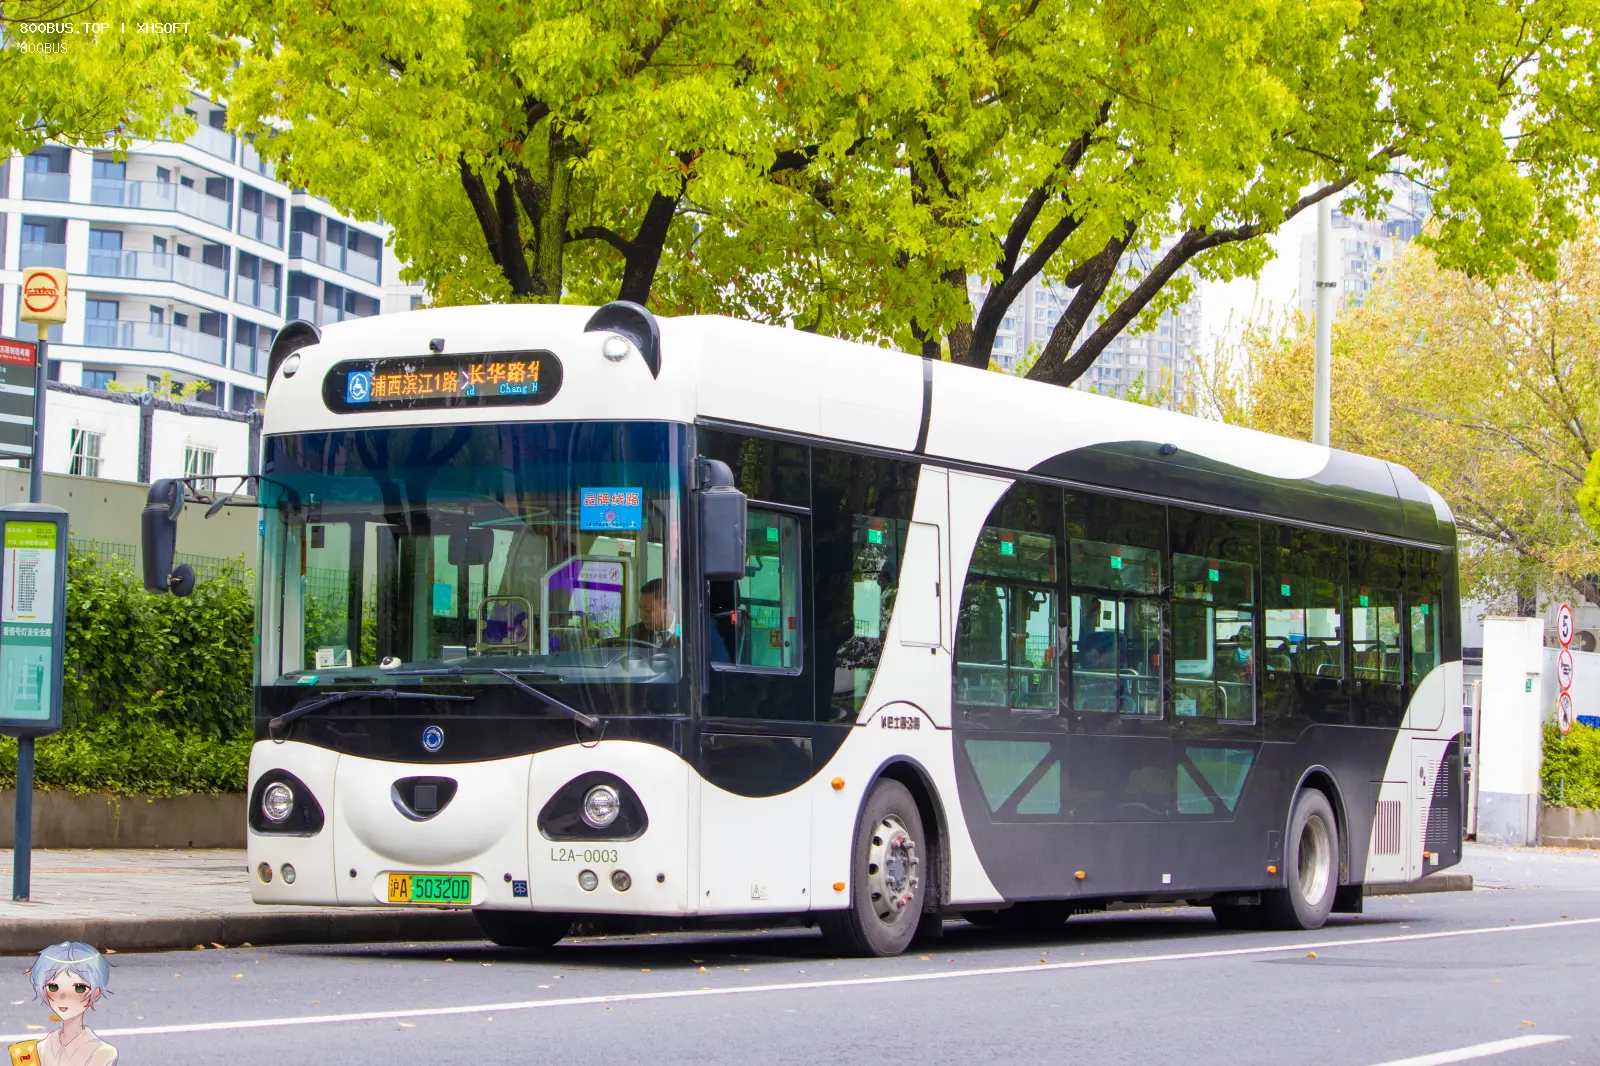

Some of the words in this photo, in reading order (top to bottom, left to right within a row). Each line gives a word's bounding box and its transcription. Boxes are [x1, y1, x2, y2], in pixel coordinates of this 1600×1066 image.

[370, 370, 457, 397] 浦西滨江1路
[500, 382, 528, 394] Chang
[583, 492, 639, 506] 品牌线路
[1562, 614, 1569, 638] 5
[550, 847, 618, 863] L2A-0003
